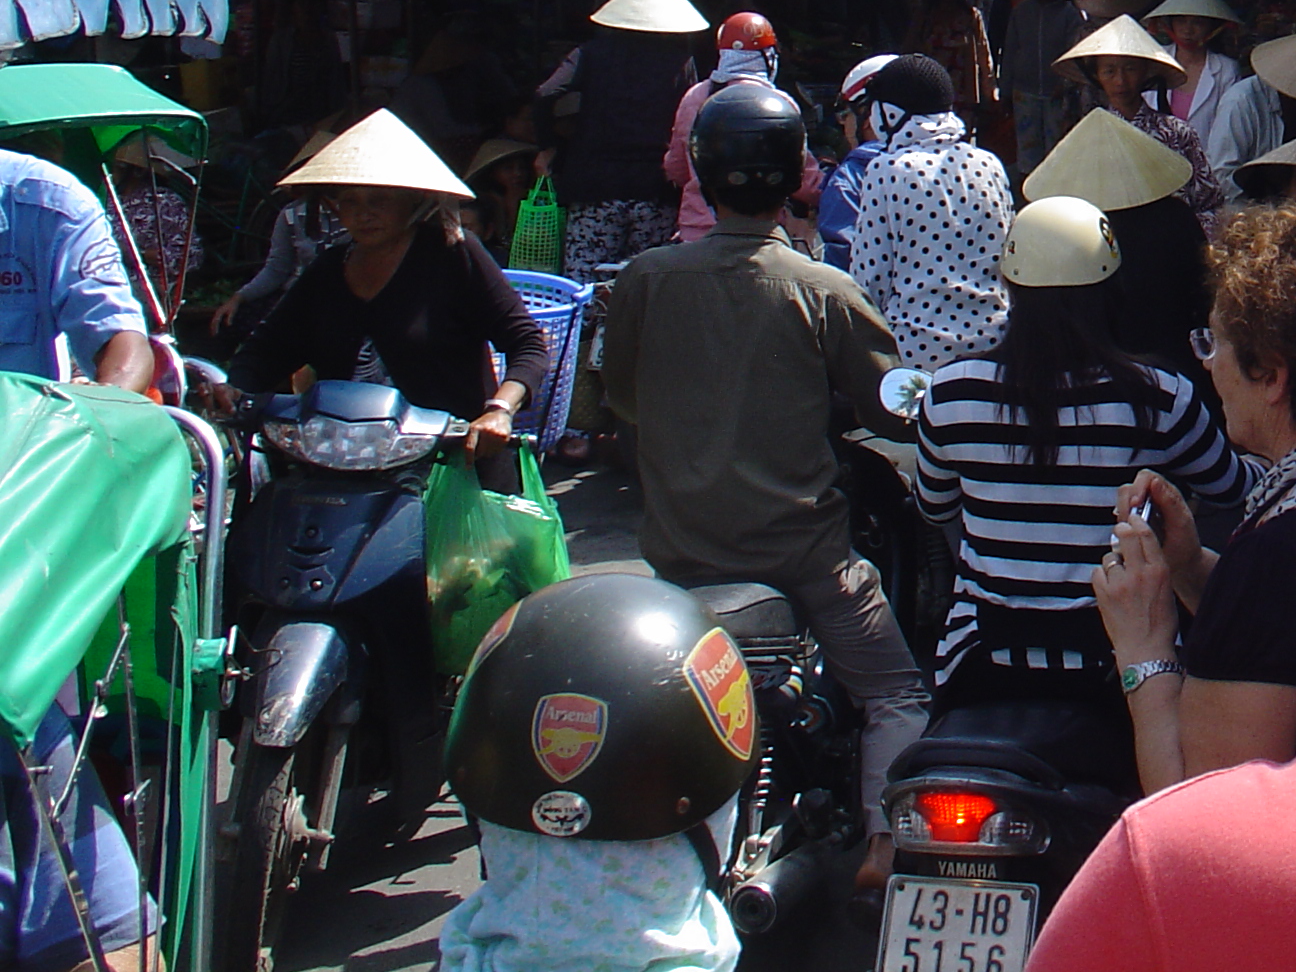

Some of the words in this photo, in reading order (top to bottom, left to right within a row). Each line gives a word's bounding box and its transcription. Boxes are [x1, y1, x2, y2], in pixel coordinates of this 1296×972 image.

[547, 706, 597, 724] Arsenal
[938, 860, 997, 878] YAMAHA
[908, 888, 1011, 936] 43-H8
[901, 937, 1006, 972] 5156
